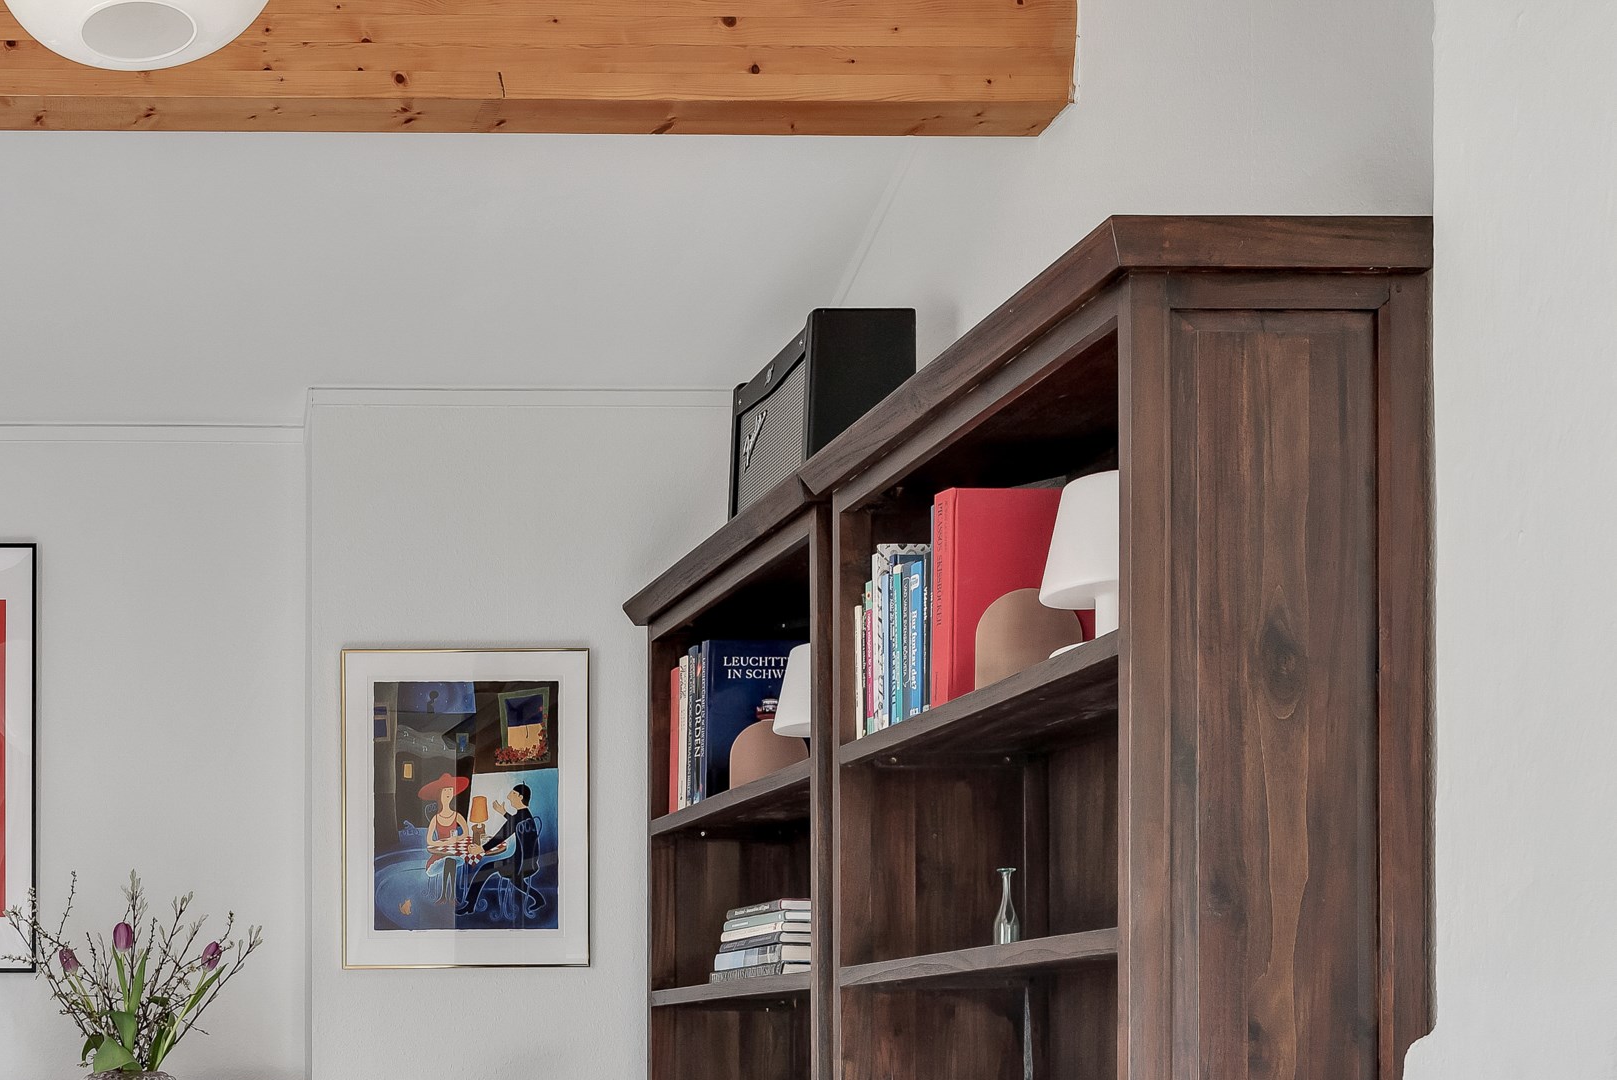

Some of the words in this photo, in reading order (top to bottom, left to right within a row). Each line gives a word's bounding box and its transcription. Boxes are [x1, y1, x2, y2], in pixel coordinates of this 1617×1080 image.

[723, 656, 789, 666] LEUCHTT
[728, 669, 742, 679] IN
[746, 669, 786, 679] SCHW
